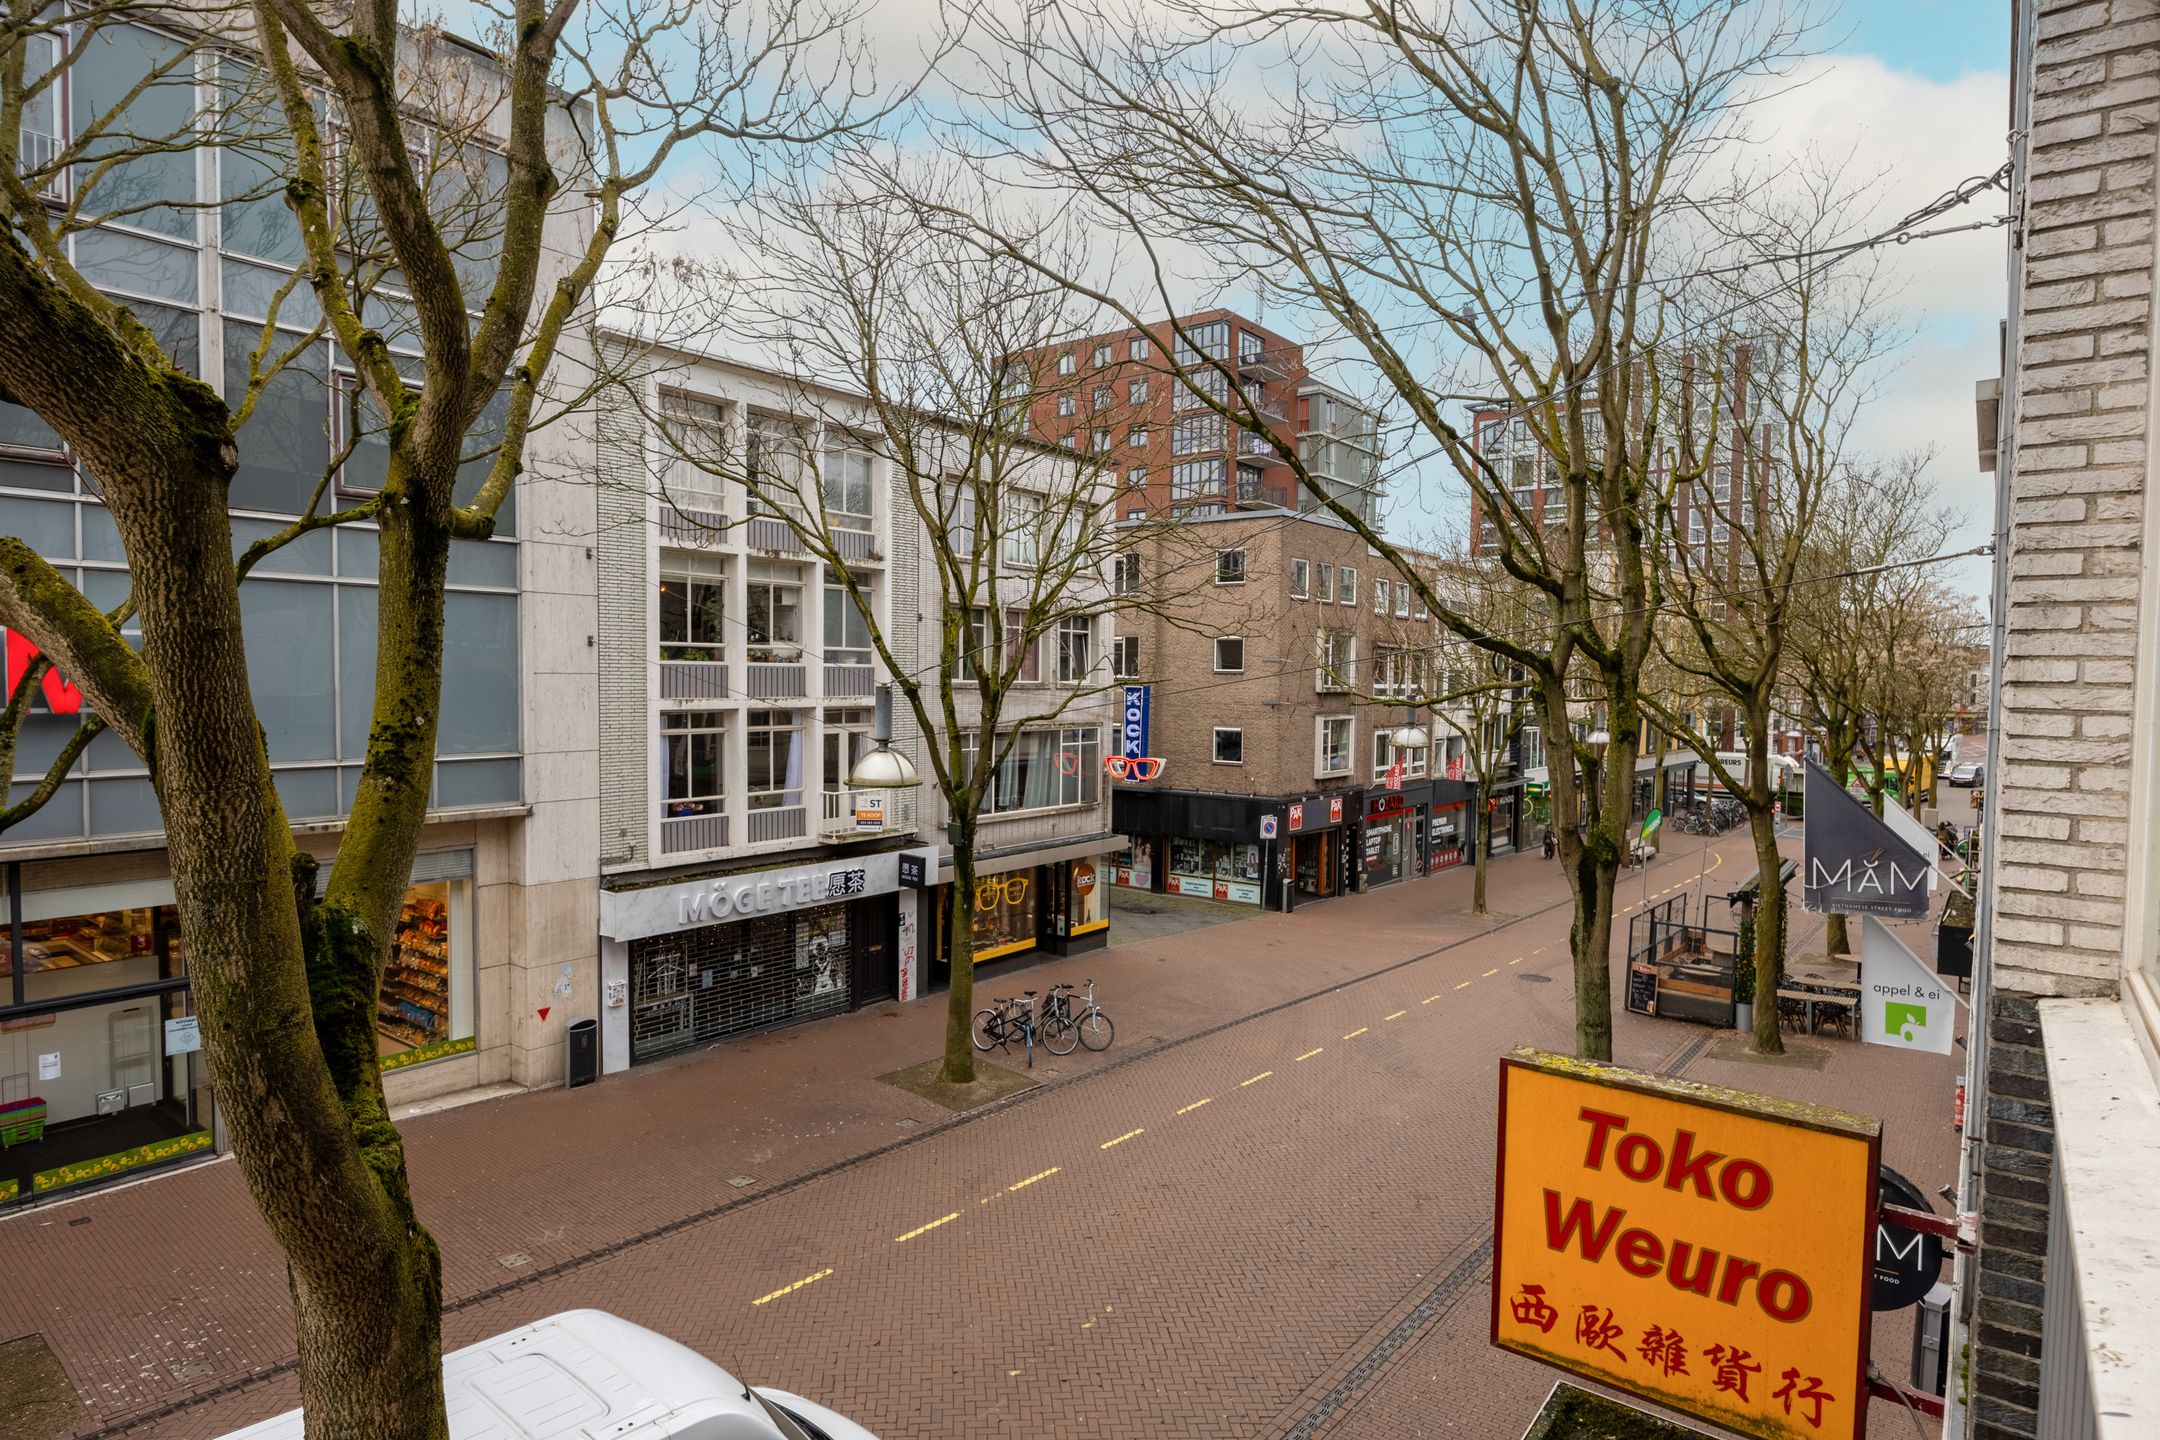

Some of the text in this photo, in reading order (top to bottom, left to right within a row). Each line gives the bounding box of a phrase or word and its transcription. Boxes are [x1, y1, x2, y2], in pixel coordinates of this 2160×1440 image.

[1126, 692, 1141, 754] KOCK
[870, 800, 881, 808] ST
[1373, 795, 1405, 812] HOZARD
[1366, 824, 1393, 838] SMARTPHONE
[1366, 836, 1382, 847] LAPTOP
[1365, 845, 1381, 856] TABLET
[827, 868, 866, 898] 愿茶
[1076, 873, 1096, 885] kock
[678, 874, 827, 925] MÖGE TEE
[1870, 904, 1892, 912] STREET
[1893, 906, 1912, 914] FOOD
[1873, 984, 1940, 1000] appel & ei
[1578, 1106, 1774, 1211] Toko
[1543, 1187, 1813, 1324] Weuro
[1880, 1274, 1900, 1285] FOOD
[1510, 1284, 1836, 1429] 西歐雜貨行
